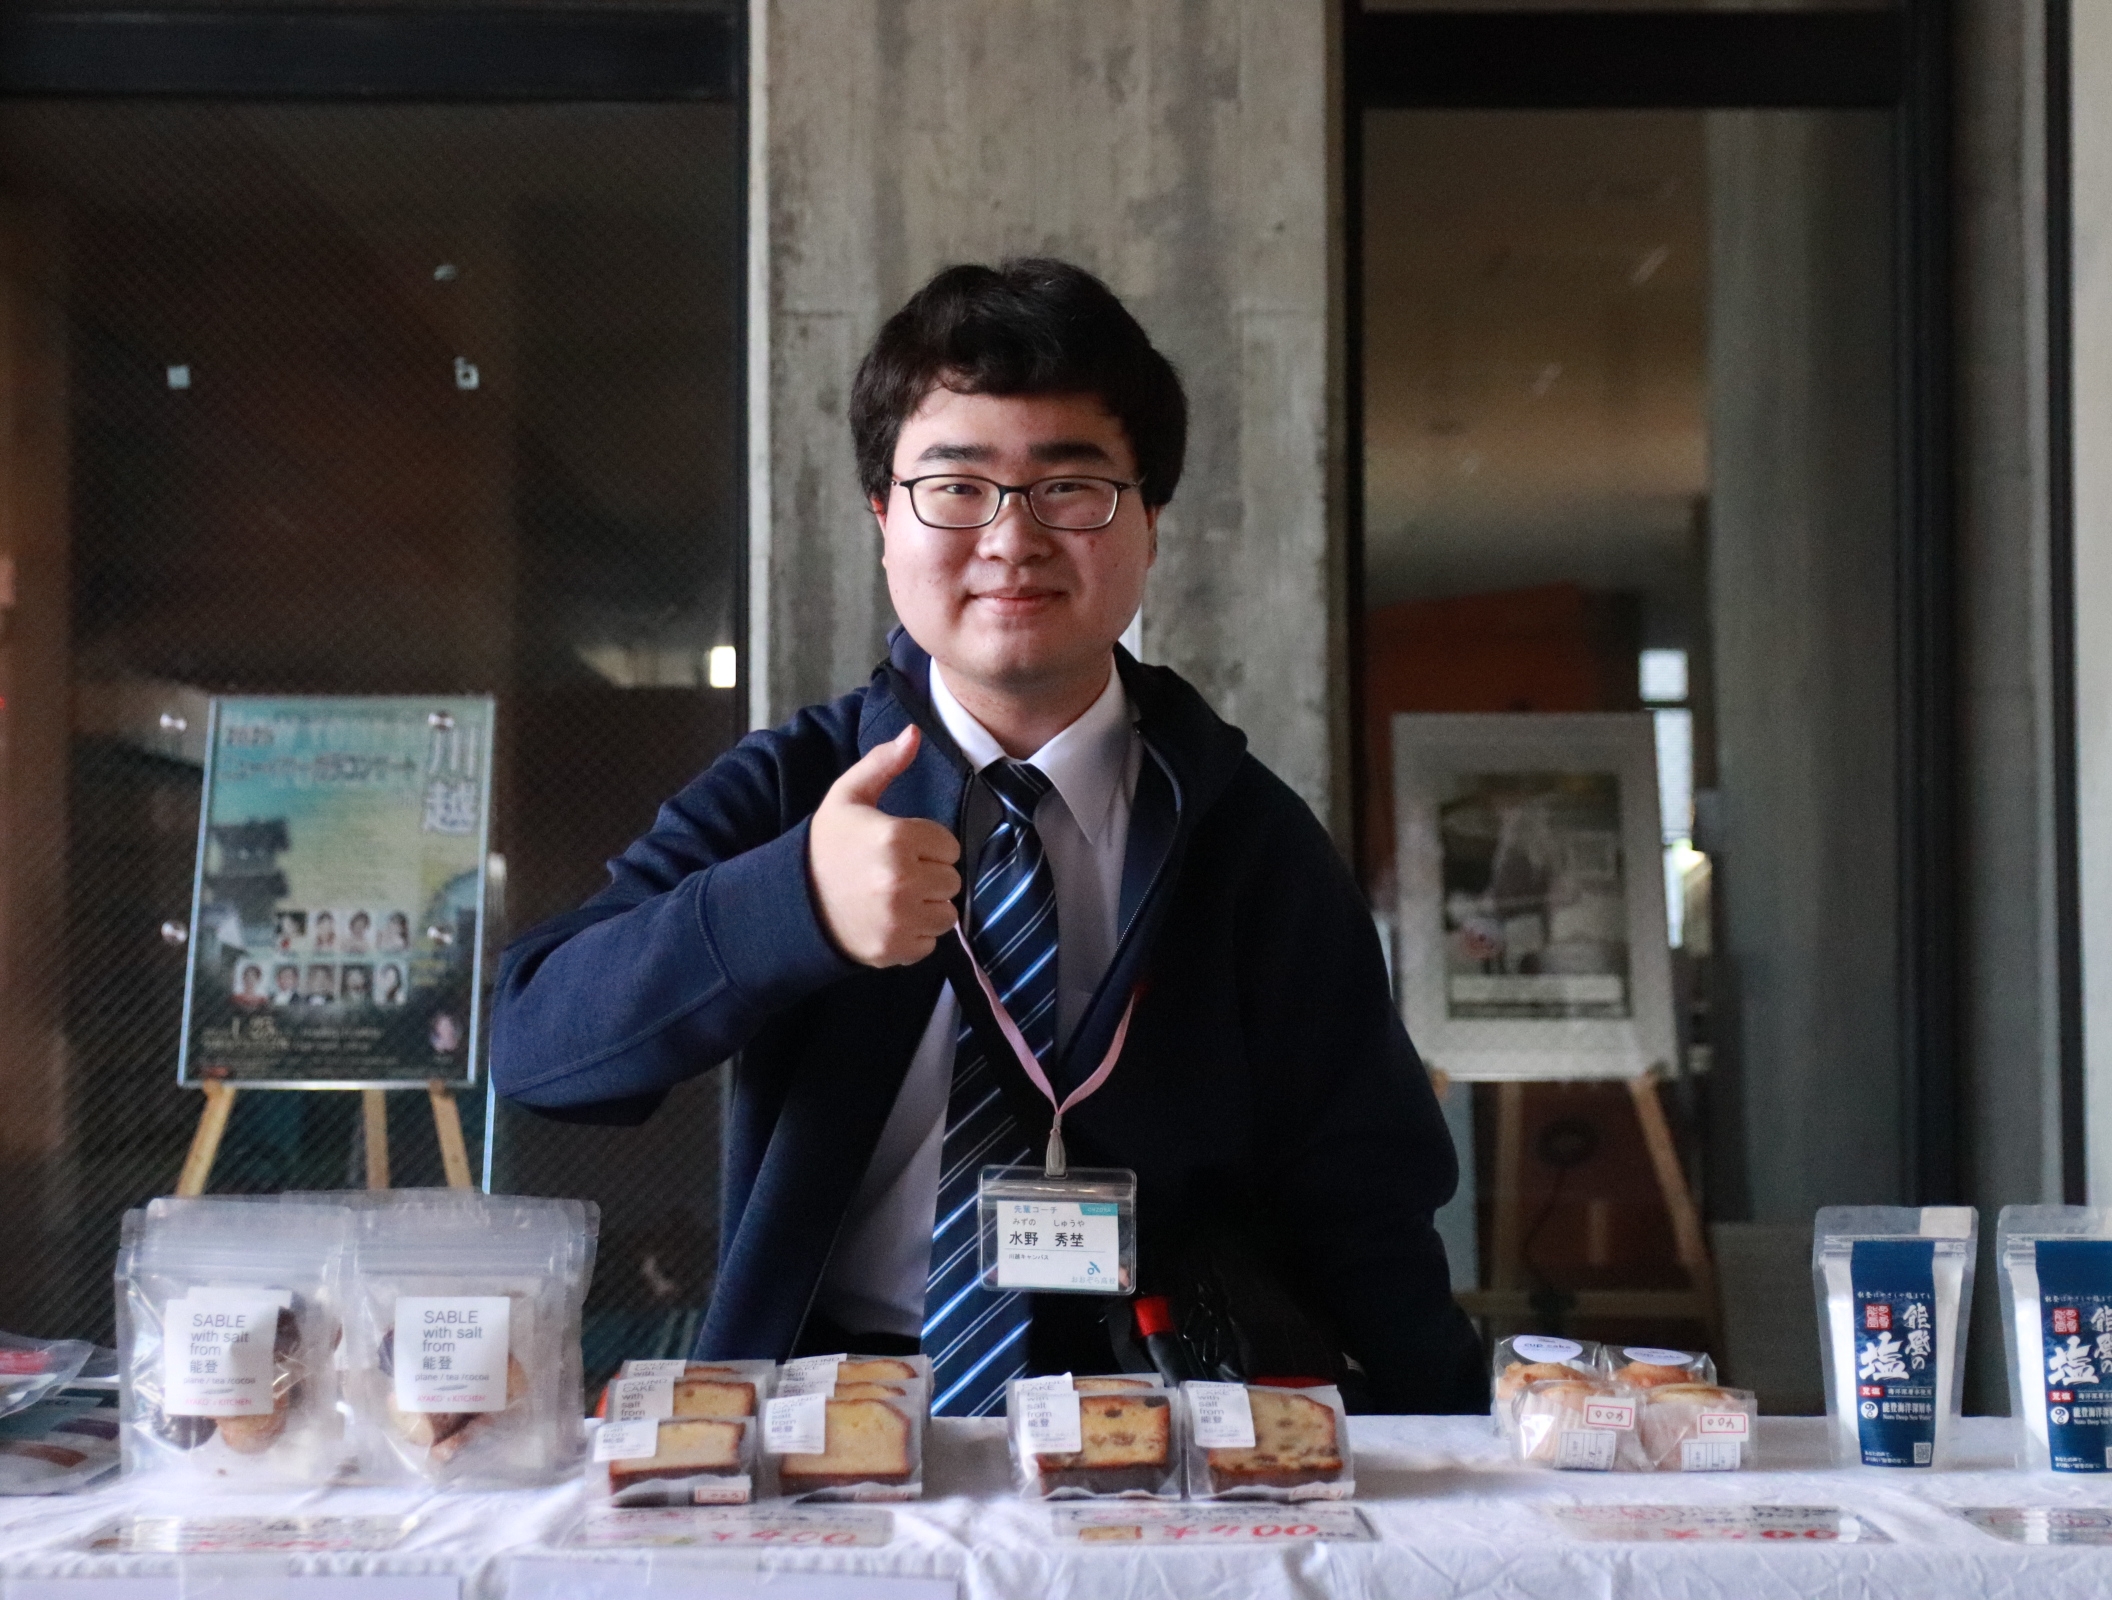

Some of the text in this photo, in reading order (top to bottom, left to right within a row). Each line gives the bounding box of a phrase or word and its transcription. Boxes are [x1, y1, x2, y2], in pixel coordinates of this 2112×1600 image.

[1014, 1205, 1057, 1214] 先輩コーチ
[1013, 1218, 1085, 1228] みずの しゅうや
[1009, 1231, 1085, 1247] 水野 秀埜
[1071, 1276, 1116, 1285] おおぞら高校
[192, 1313, 246, 1328] SABLE
[424, 1310, 479, 1324] SABLE
[191, 1331, 249, 1343] with salt
[423, 1326, 483, 1339] with salt
[1903, 1302, 1931, 1370] 能登の
[190, 1343, 220, 1356] from
[422, 1339, 456, 1353] from
[1859, 1331, 1910, 1381] 塩
[2048, 1335, 2100, 1386] 塩
[189, 1360, 218, 1374] 能登
[422, 1356, 453, 1370] 能登
[622, 1385, 656, 1393] CAKE
[623, 1379, 668, 1387] POUND
[1862, 1386, 1881, 1396] 荒塩
[1026, 1402, 1046, 1410] salt
[1882, 1402, 1932, 1414] 能登海洋深層水
[1027, 1418, 1050, 1428] 能登
[1707, 1418, 1735, 1430] 400
